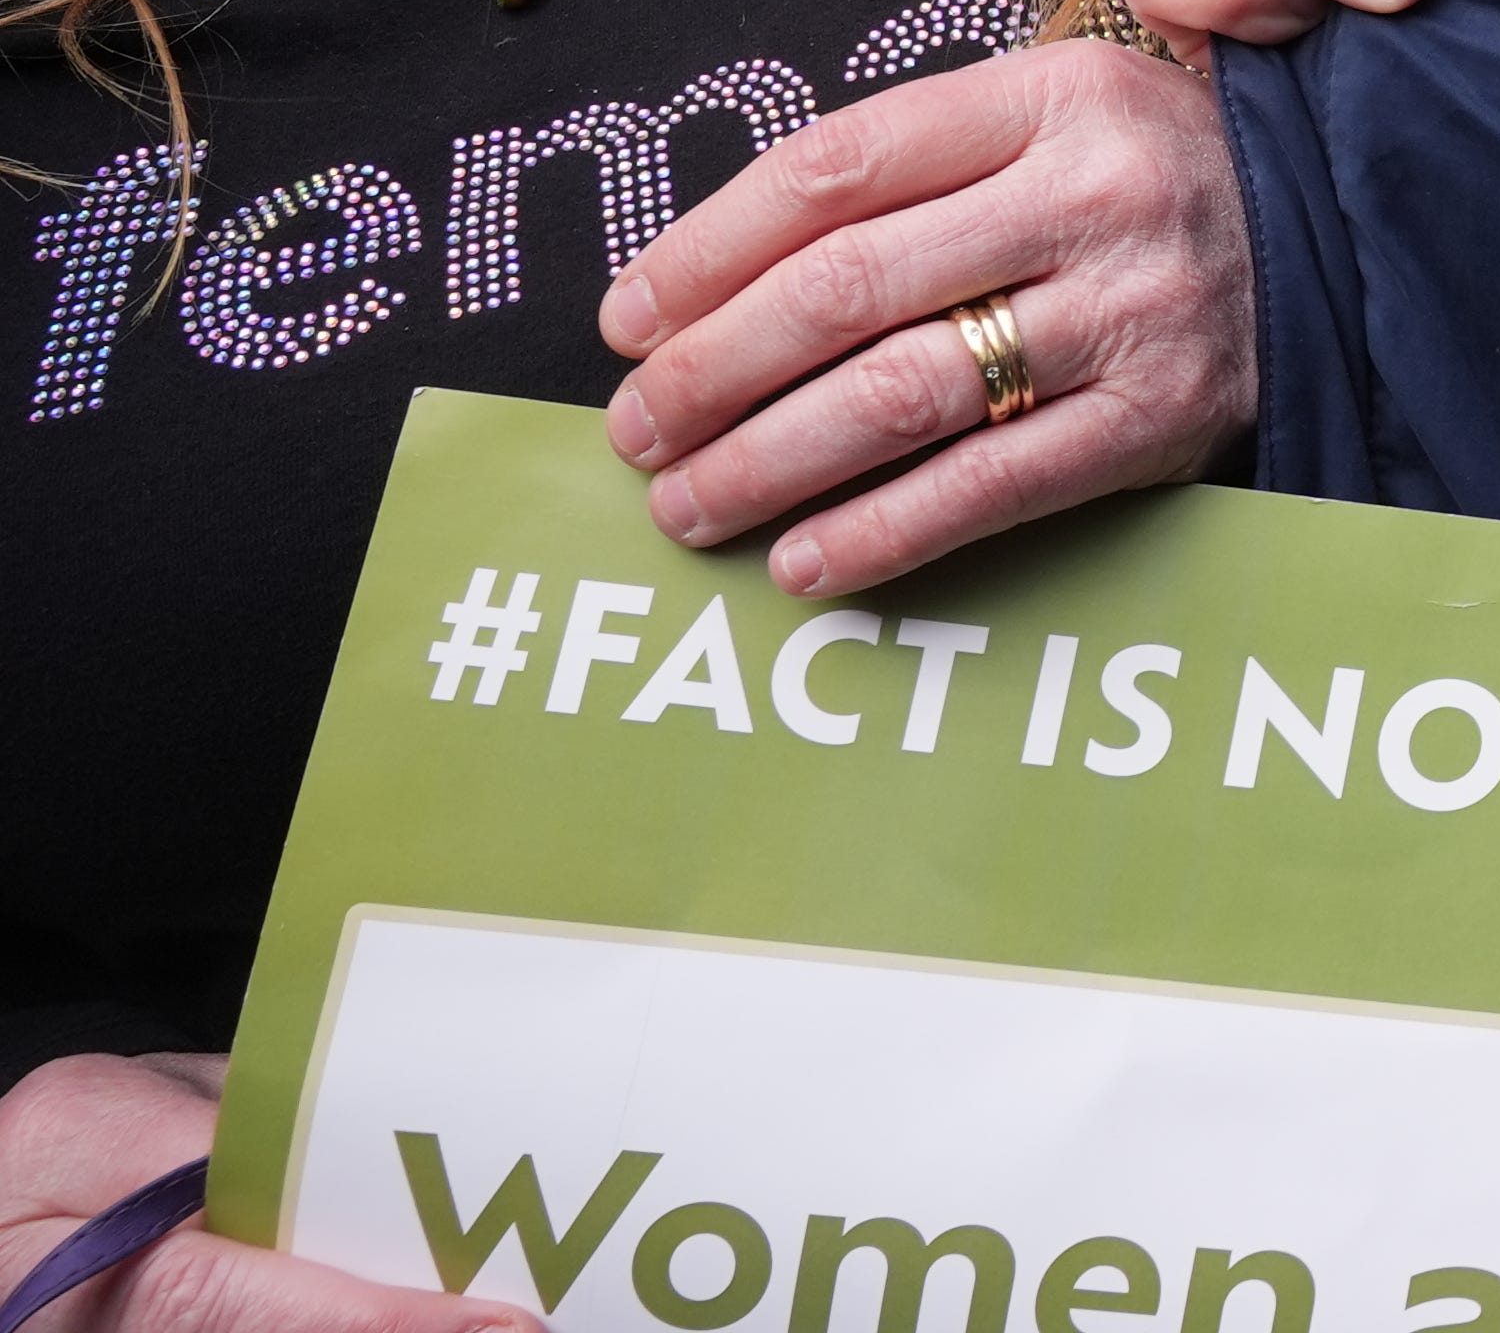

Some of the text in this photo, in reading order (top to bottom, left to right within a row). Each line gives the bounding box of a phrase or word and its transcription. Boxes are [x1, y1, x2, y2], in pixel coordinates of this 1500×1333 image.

[427, 567, 990, 754] #FACT
[1020, 634, 1182, 777] IS
[394, 1130, 1316, 1333] Women
